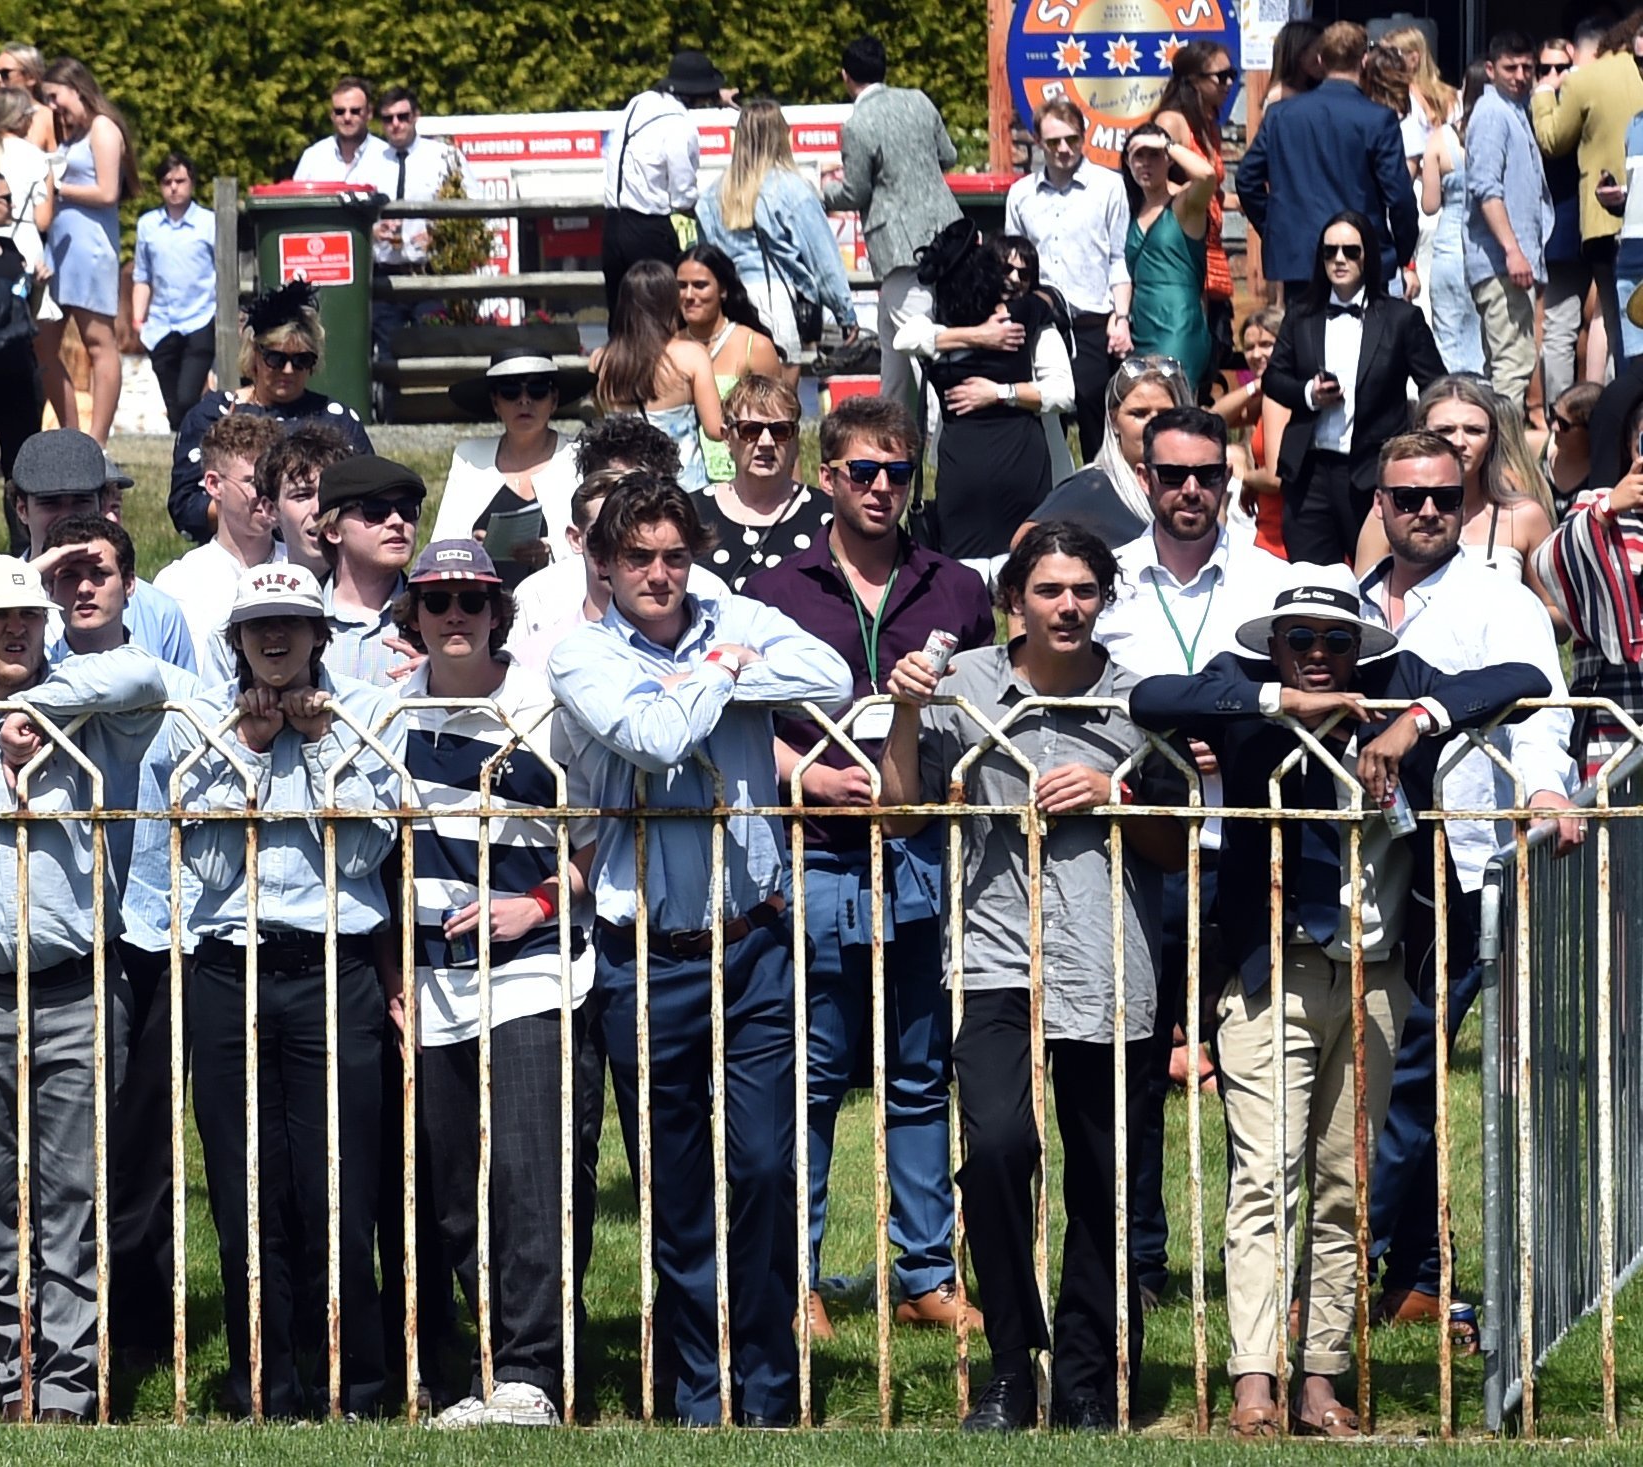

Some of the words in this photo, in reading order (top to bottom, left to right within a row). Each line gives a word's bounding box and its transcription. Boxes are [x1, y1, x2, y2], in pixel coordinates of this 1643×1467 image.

[462, 140, 525, 155] FLAVOURED
[575, 137, 596, 152] ICE
[798, 130, 838, 146] FRESH
[252, 573, 301, 591] NIKE
